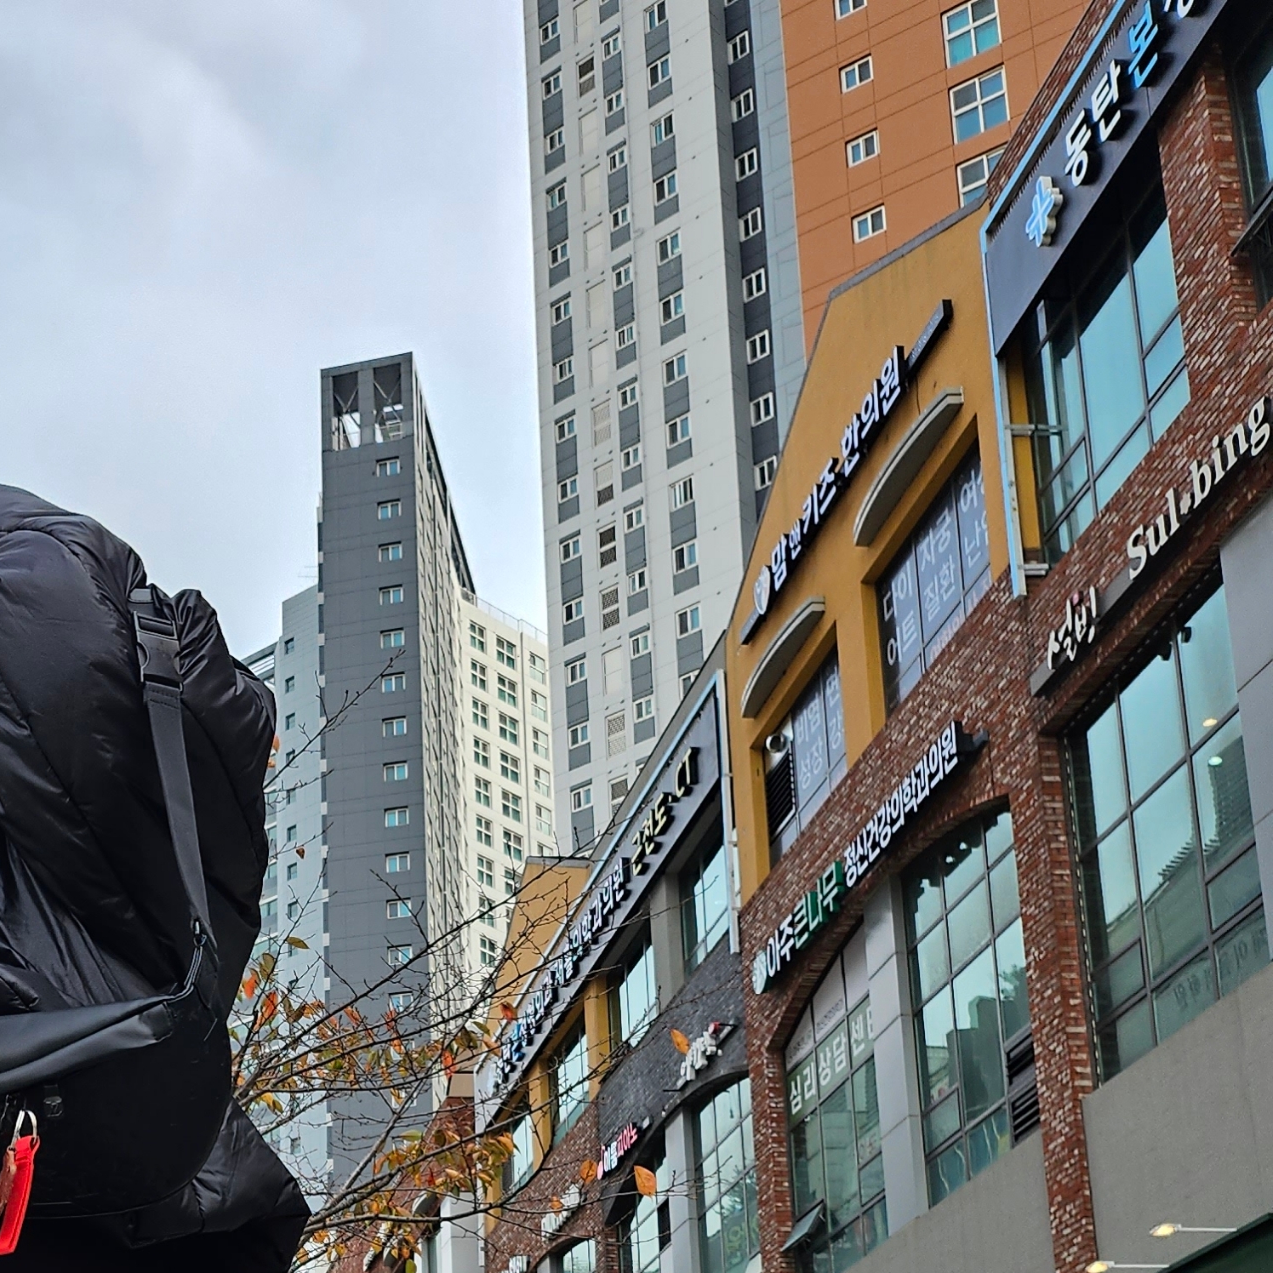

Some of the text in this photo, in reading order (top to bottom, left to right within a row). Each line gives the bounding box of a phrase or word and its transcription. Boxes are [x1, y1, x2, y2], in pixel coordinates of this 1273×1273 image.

[841, 345, 900, 477] 한의원
[920, 508, 951, 572] 자궁
[924, 555, 955, 622] 질환
[794, 693, 821, 745] 비염
[799, 737, 823, 790] 성장
[767, 862, 840, 978] 아주큰나무
[844, 720, 958, 888] 정신건강의학과의원
